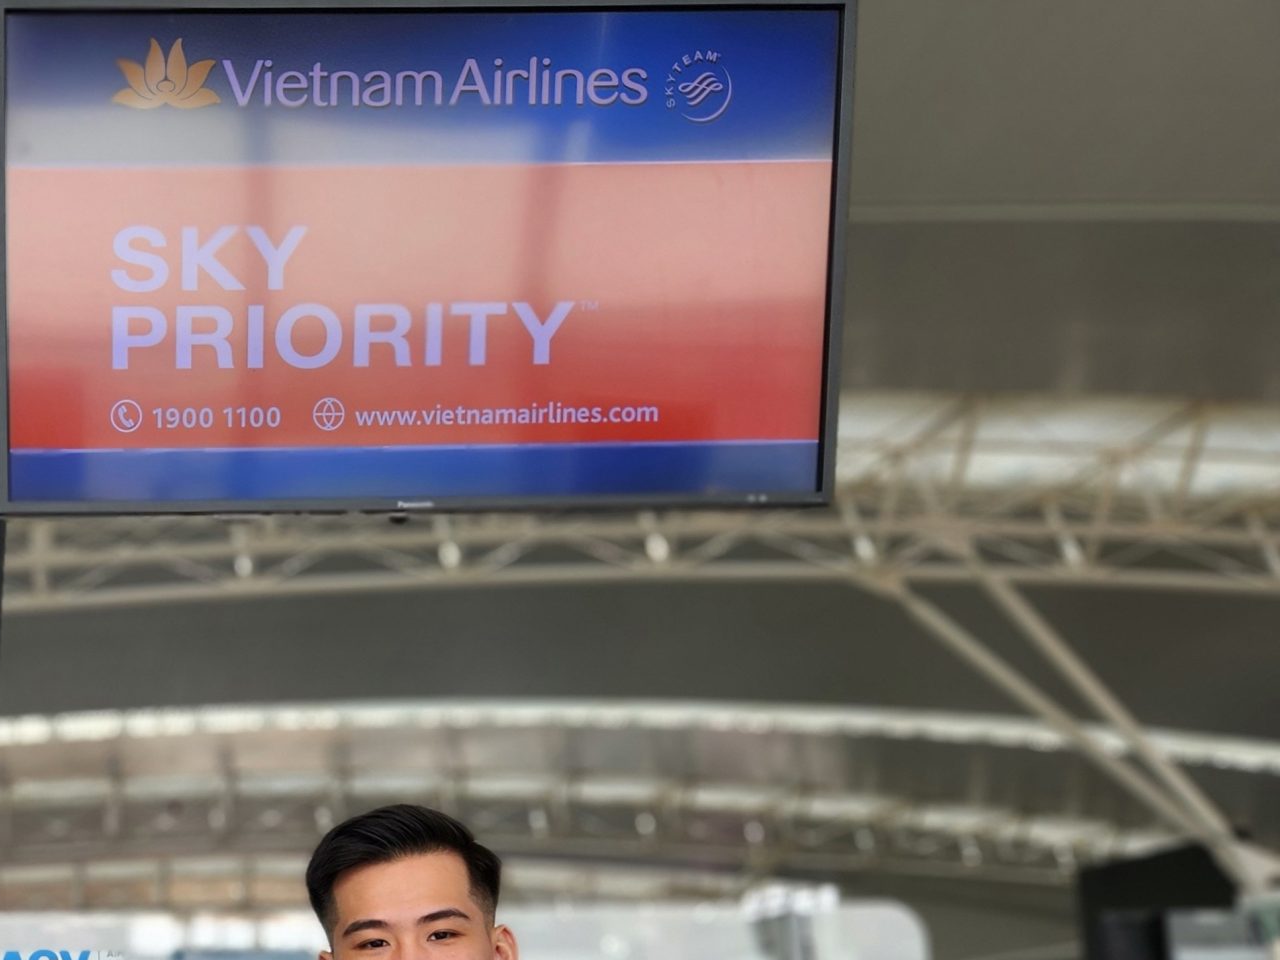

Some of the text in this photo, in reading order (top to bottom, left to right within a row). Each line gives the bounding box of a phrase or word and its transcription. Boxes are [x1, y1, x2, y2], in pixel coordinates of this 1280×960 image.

[222, 56, 649, 107] Vietnam Airlines
[664, 50, 719, 108] SKYTEAM
[110, 226, 309, 293] SKY
[111, 302, 575, 370] PRIORITY
[153, 406, 282, 429] 1900 1100
[355, 402, 659, 427] www.vietnamairlines.com
